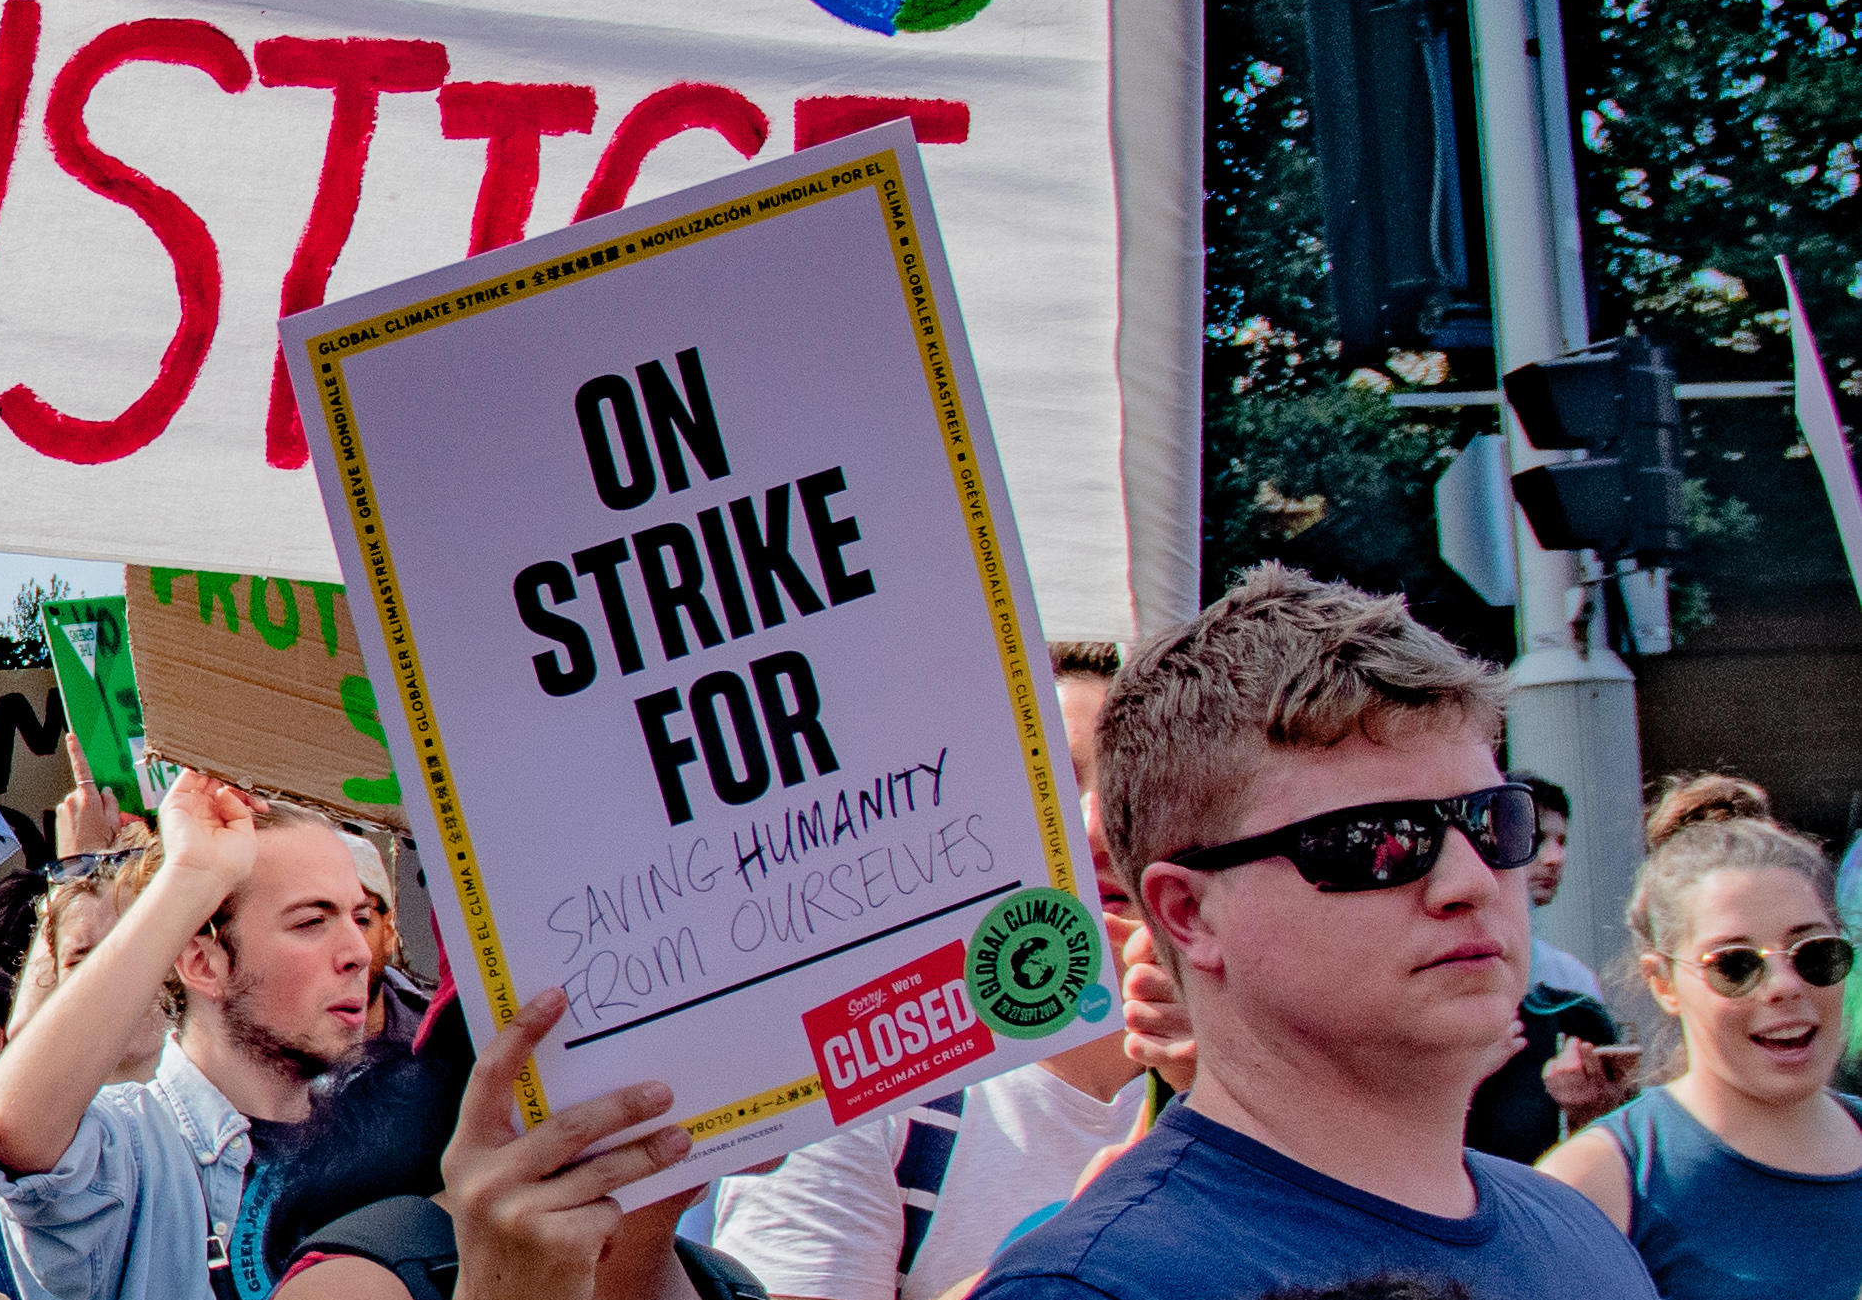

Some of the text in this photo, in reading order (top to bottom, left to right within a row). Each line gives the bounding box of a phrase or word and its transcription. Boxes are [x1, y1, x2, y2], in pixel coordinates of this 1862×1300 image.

[638, 160, 907, 250] MOVILIZACIÓN MUNDIAL POR EL CLIMA
[316, 281, 511, 356] GLOBAL CLIMATE STRIKE
[901, 251, 964, 446] GLOBALER KLIMASTREIK
[321, 374, 373, 520] GRÈVE MONDIALE
[574, 346, 731, 511] ON
[366, 538, 407, 645] KLIMASTREIK
[512, 465, 876, 698] STRIKE
[974, 524, 1006, 608] MONDIALE
[996, 612, 1018, 656] POUR
[1008, 659, 1024, 679] LE
[396, 648, 431, 732] GLOBALER
[1013, 683, 1038, 740] CLIMAT
[634, 650, 840, 828] FOR
[1031, 762, 1053, 803] JEDA
[547, 747, 948, 965] SAVING HUMANITY
[1039, 805, 1065, 858] UNTUK
[458, 865, 502, 978] POR EL CLIMA
[561, 813, 996, 1029] FROM OURSELVES
[976, 900, 1091, 1003] GLOBAL CLIMATE STRIKE
[822, 978, 977, 1089] CLOSED
[875, 1060, 931, 1094] CLIMATE
[933, 1039, 975, 1066] CRISIS
[240, 1232, 261, 1293] GREEN
